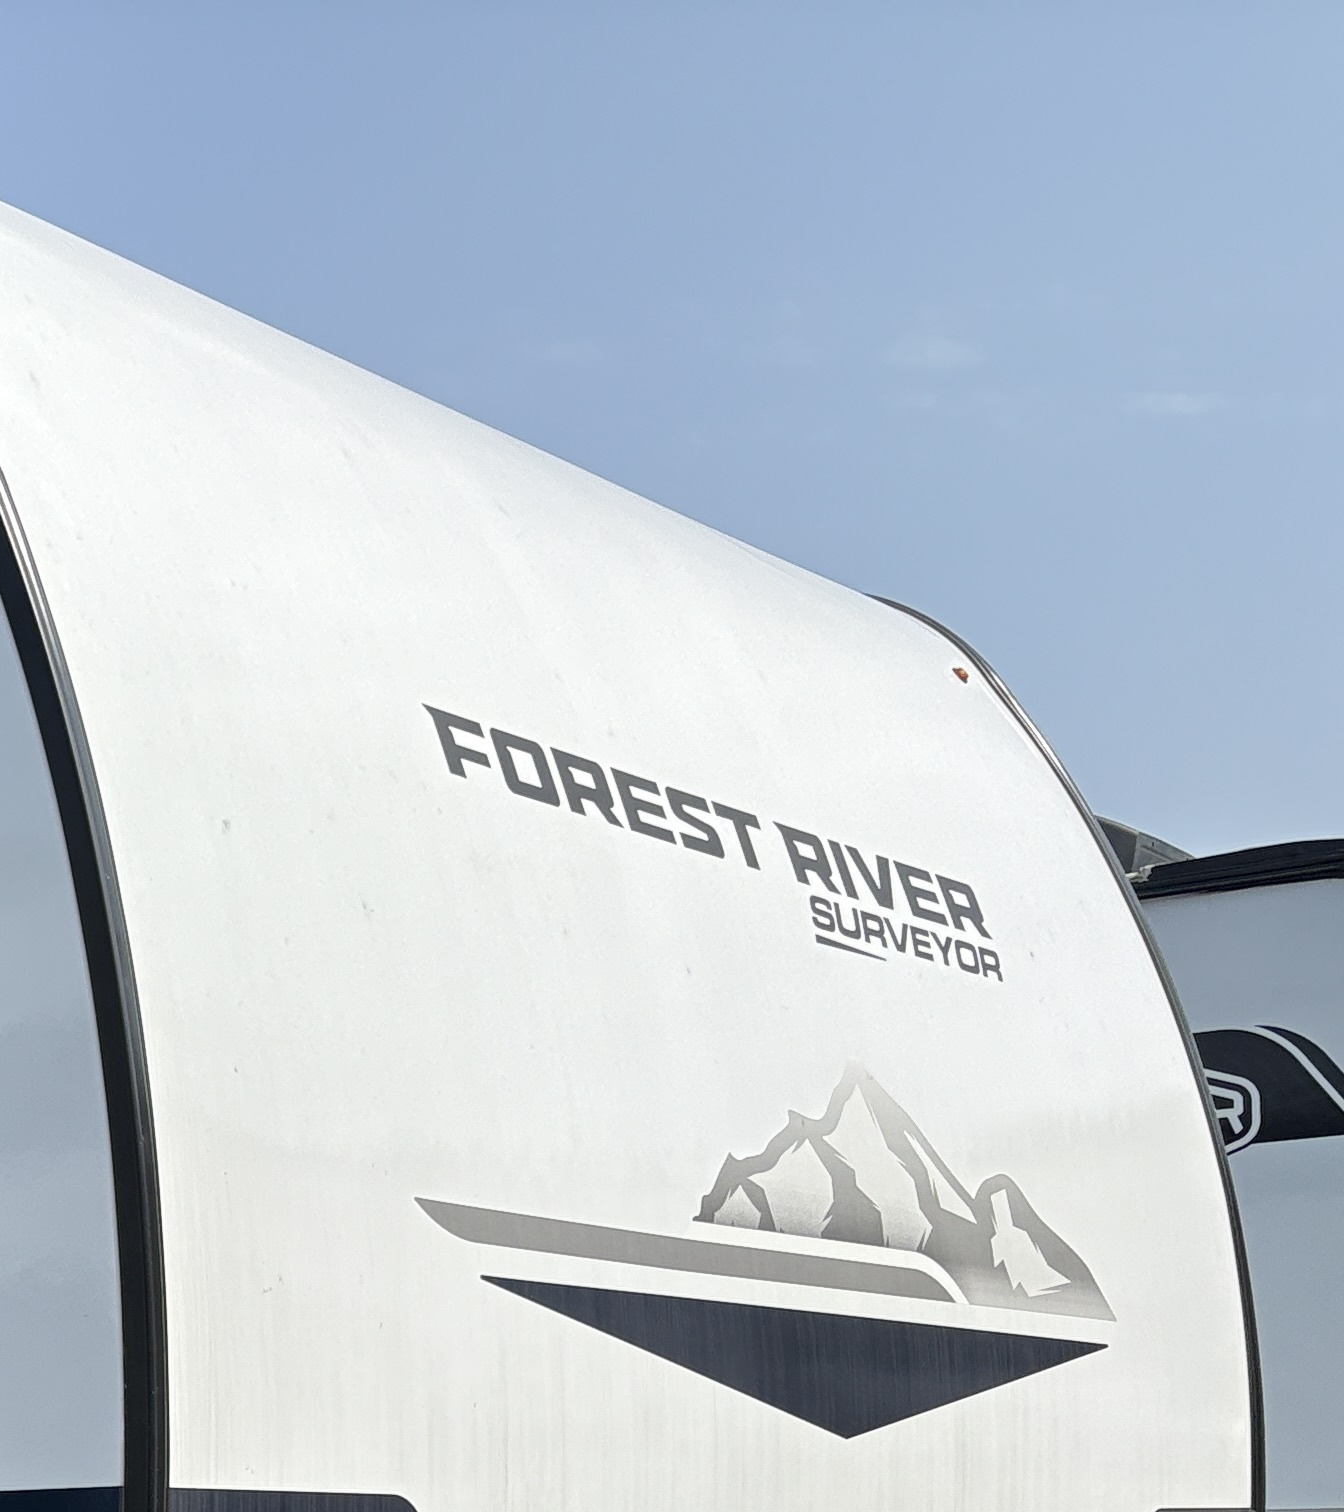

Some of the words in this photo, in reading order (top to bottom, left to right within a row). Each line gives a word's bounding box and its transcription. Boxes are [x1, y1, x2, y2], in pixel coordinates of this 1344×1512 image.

[421, 702, 762, 871] FOREST
[772, 820, 994, 940] RIVER
[810, 895, 1004, 983] SURVEYOR
